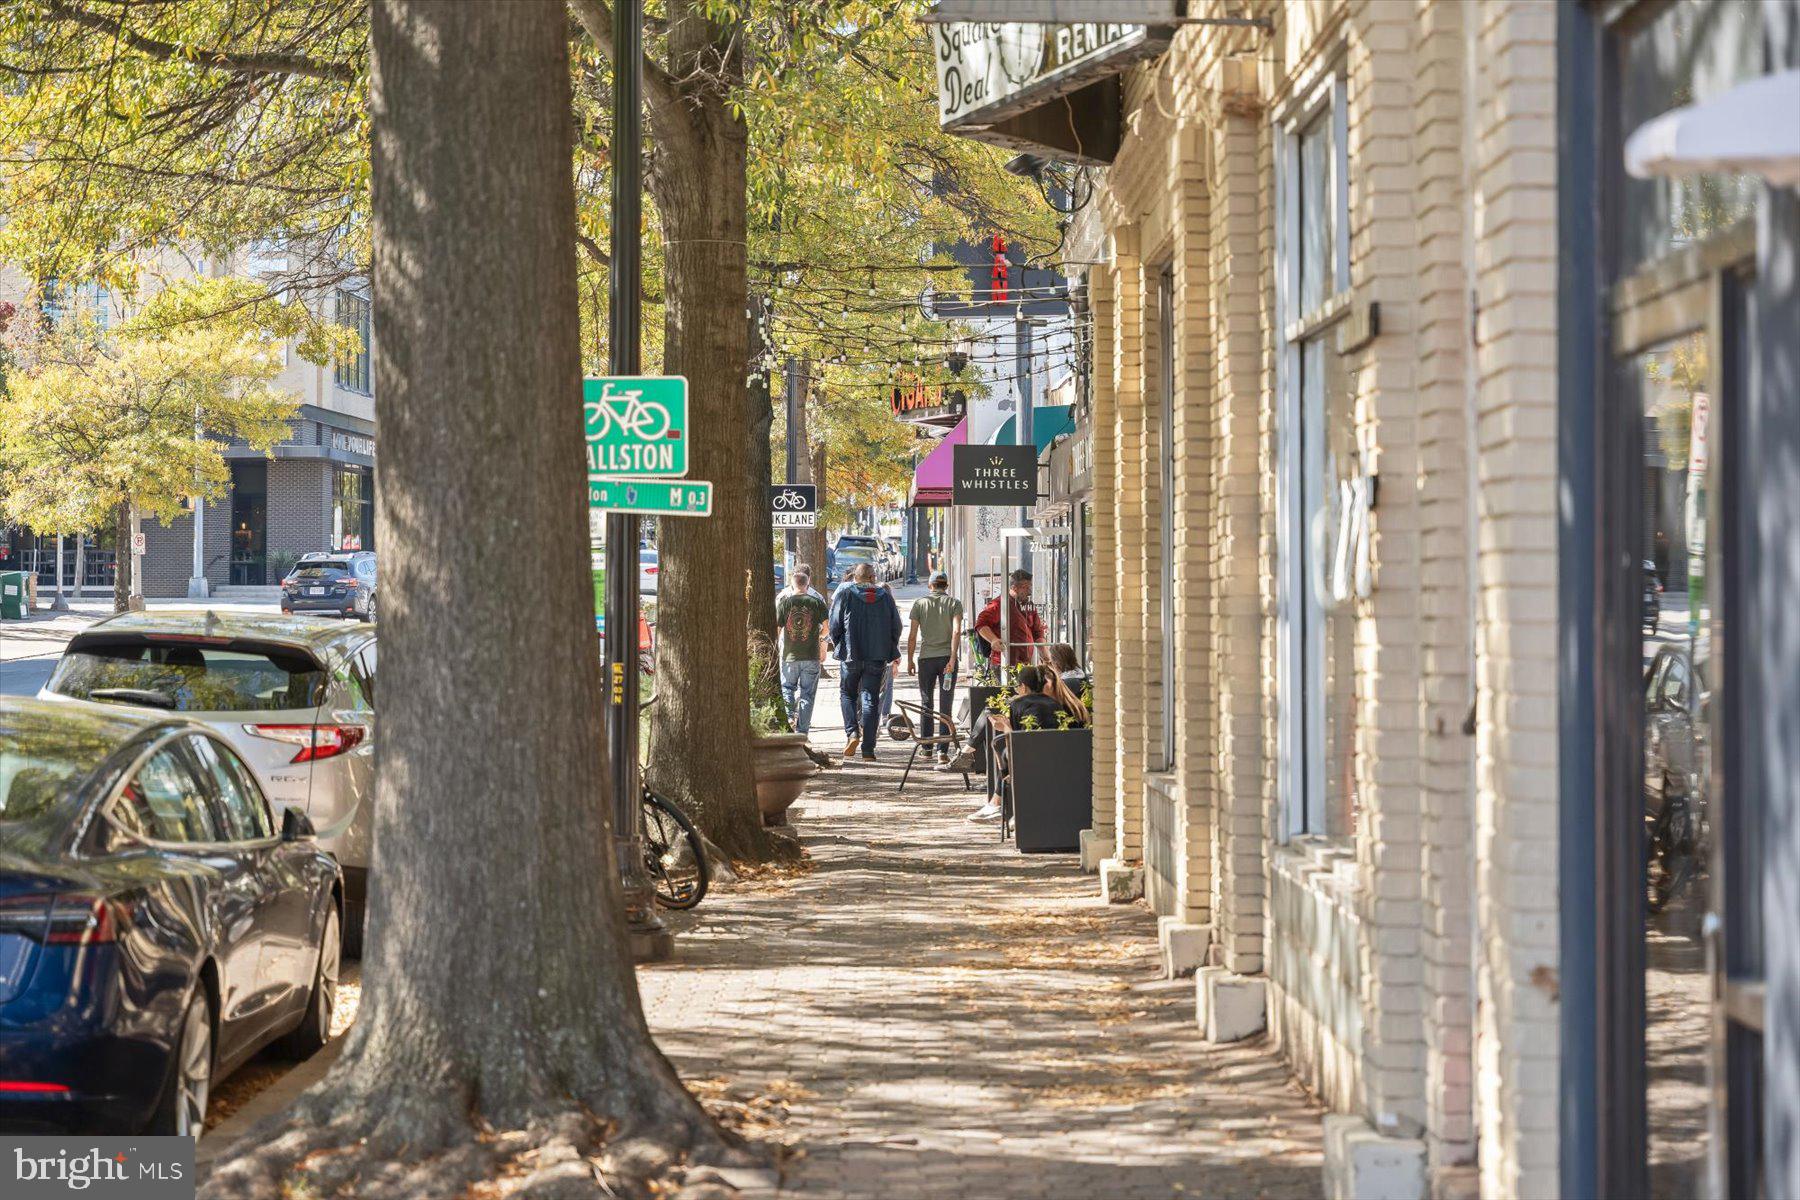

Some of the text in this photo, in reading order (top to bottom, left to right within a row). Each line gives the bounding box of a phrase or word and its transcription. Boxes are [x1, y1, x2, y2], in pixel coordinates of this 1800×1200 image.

[945, 52, 992, 115] Deal
[974, 468, 1016, 478] THREE
[961, 480, 1029, 490] WHISTLES
[688, 491, 705, 505] 0.3
[789, 514, 814, 524] LANE
